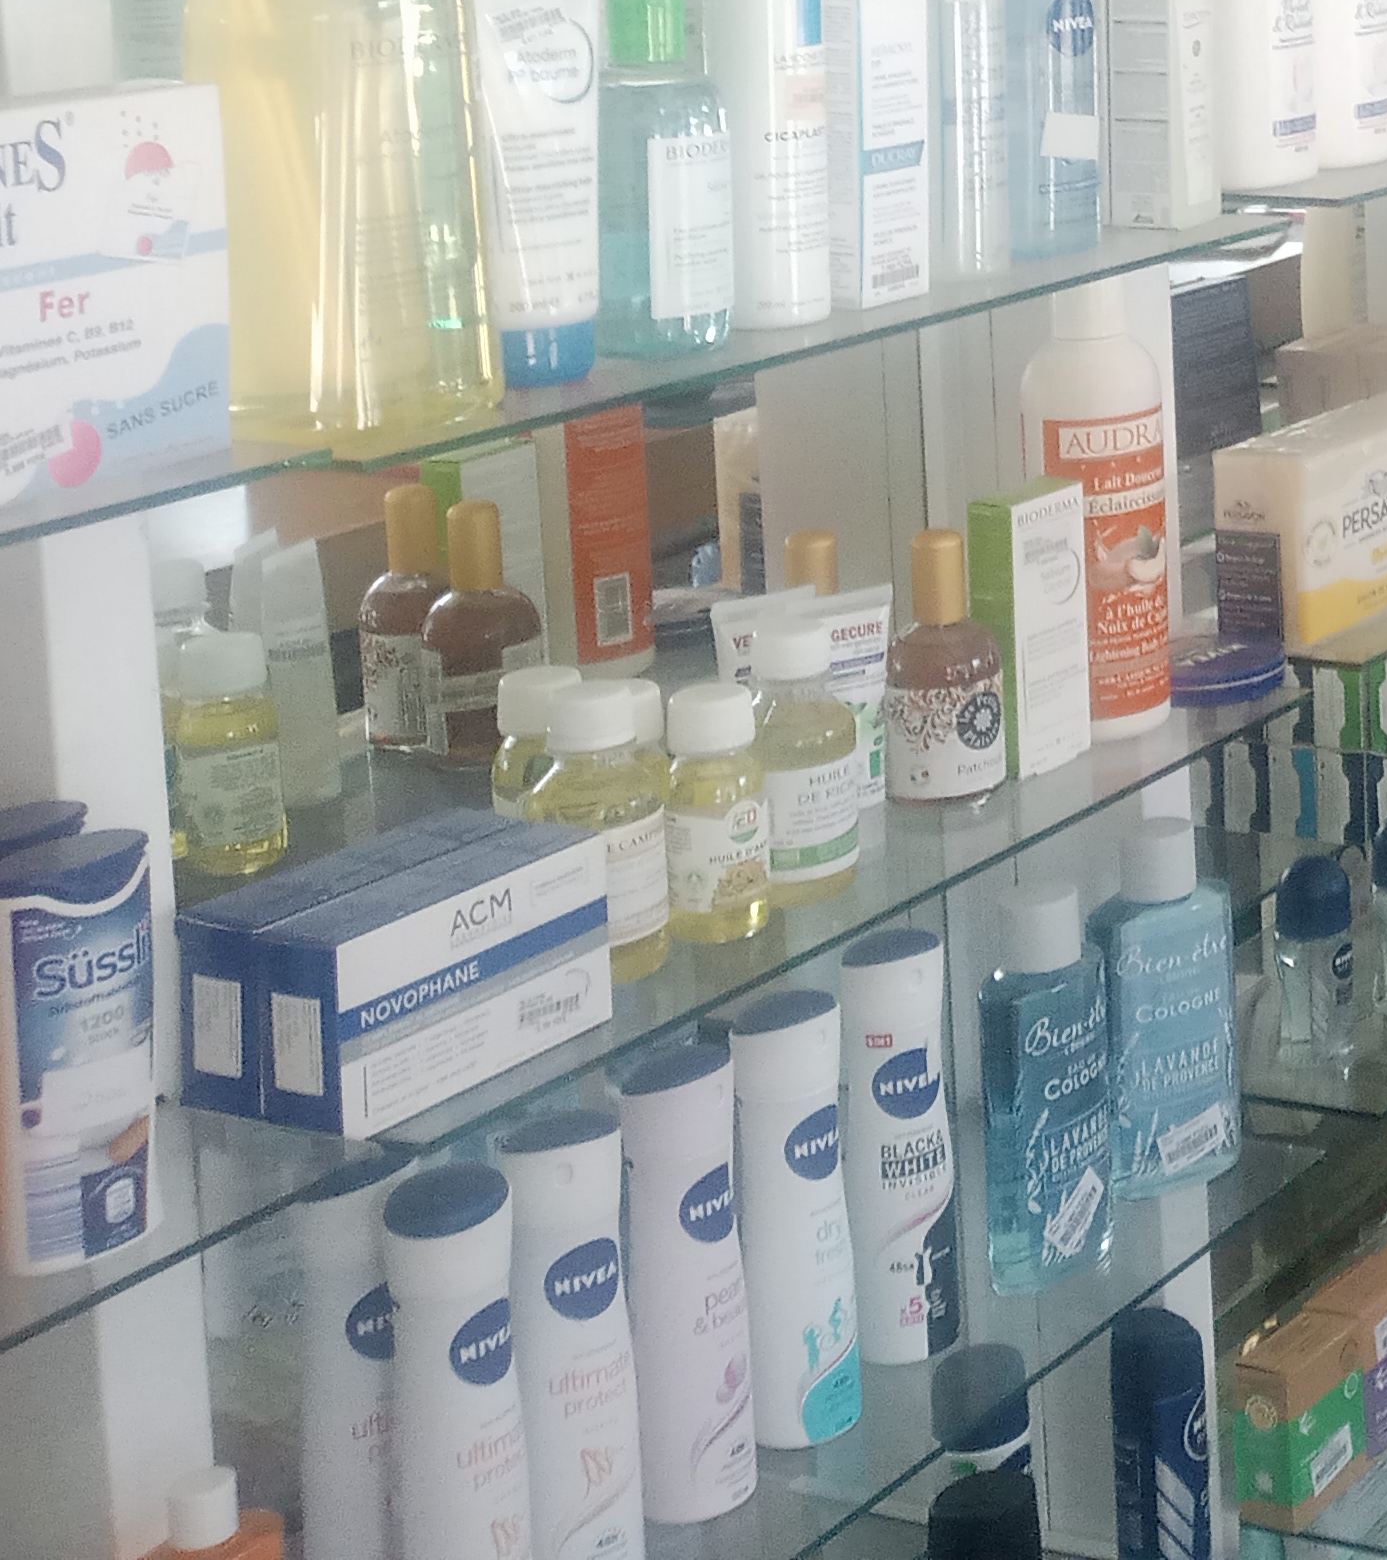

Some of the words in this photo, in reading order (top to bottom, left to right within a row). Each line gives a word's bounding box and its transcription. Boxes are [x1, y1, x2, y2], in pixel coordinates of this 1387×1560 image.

[1052, 16, 1094, 33] NIVEA
[39, 290, 91, 323] Fer
[106, 405, 156, 440] SANS
[160, 379, 220, 419] SUCRE
[1094, 476, 1123, 492] Lait
[1017, 496, 1080, 527] BIODERMA
[830, 620, 885, 643] GECURE
[449, 887, 513, 938] ACM
[359, 959, 481, 1010] NOVOPHANE
[882, 1144, 947, 1179] WHITE
[553, 1261, 619, 1295] NIVEA
